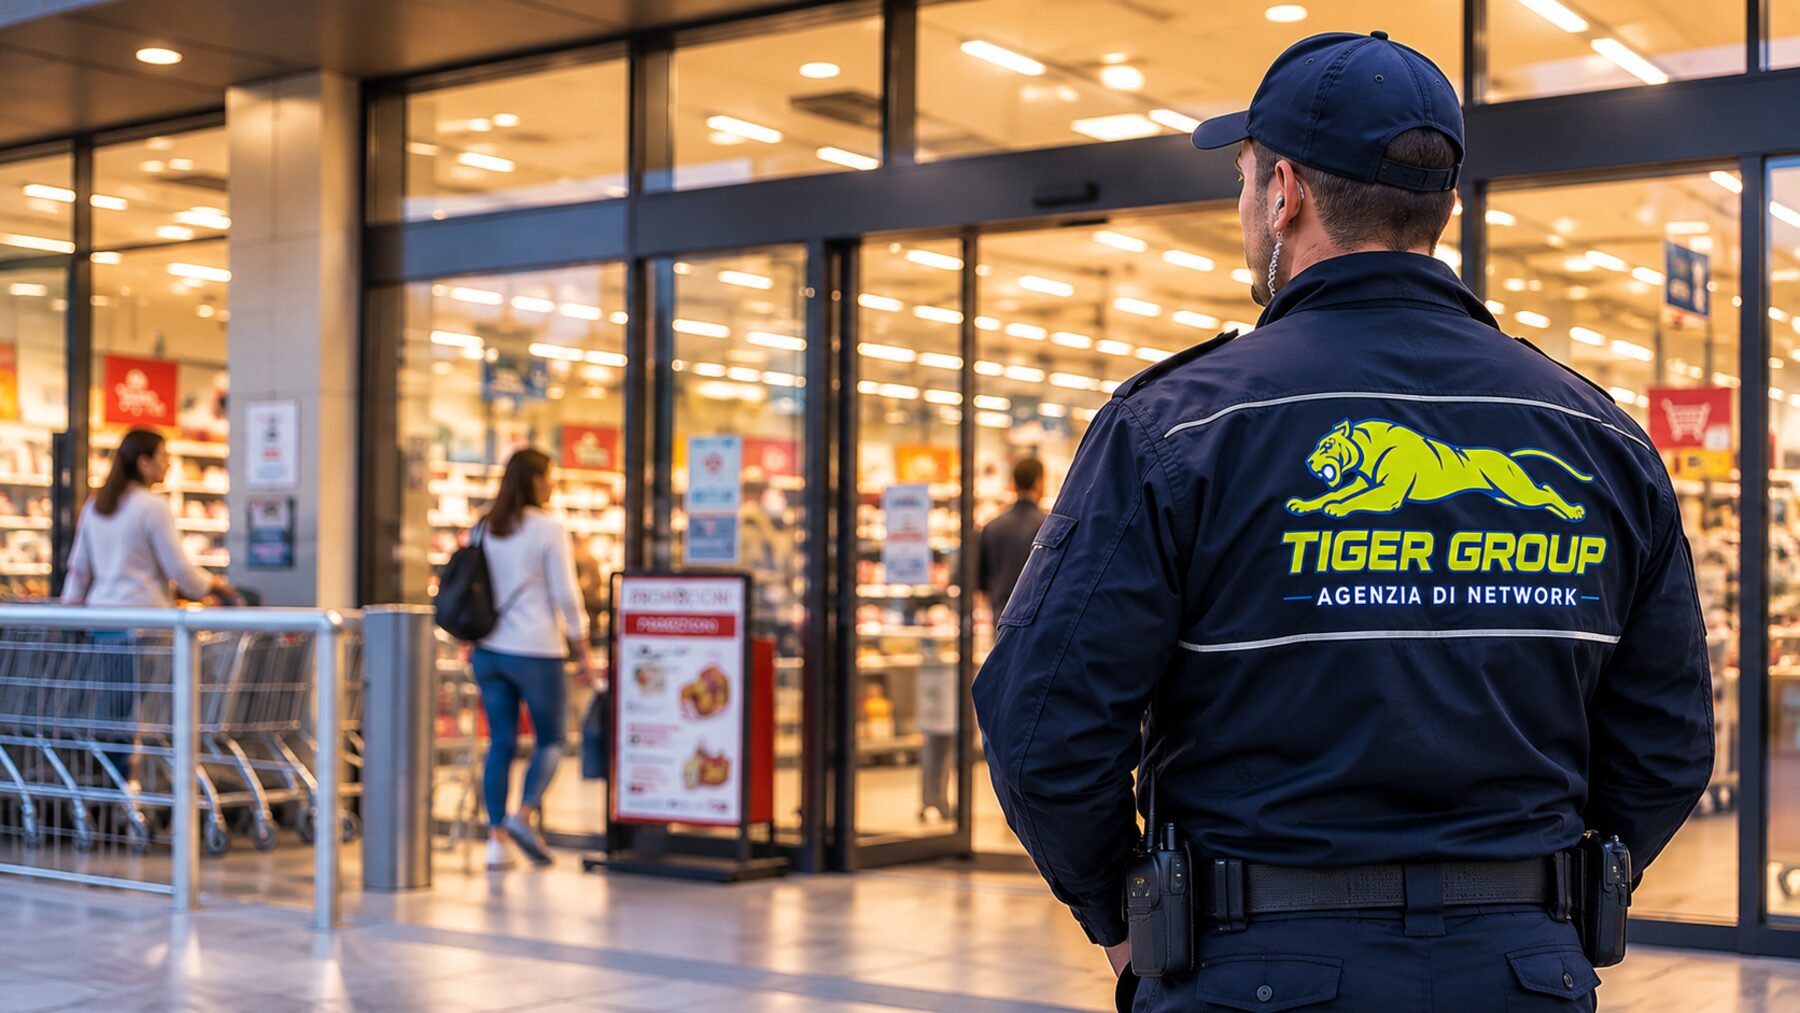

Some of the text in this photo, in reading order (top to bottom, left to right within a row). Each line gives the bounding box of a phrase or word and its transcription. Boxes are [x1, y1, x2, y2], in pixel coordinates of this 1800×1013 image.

[1281, 530, 1607, 574] TIGER GROUP
[1316, 586, 1577, 606] AGENZIA DI NETWORK
